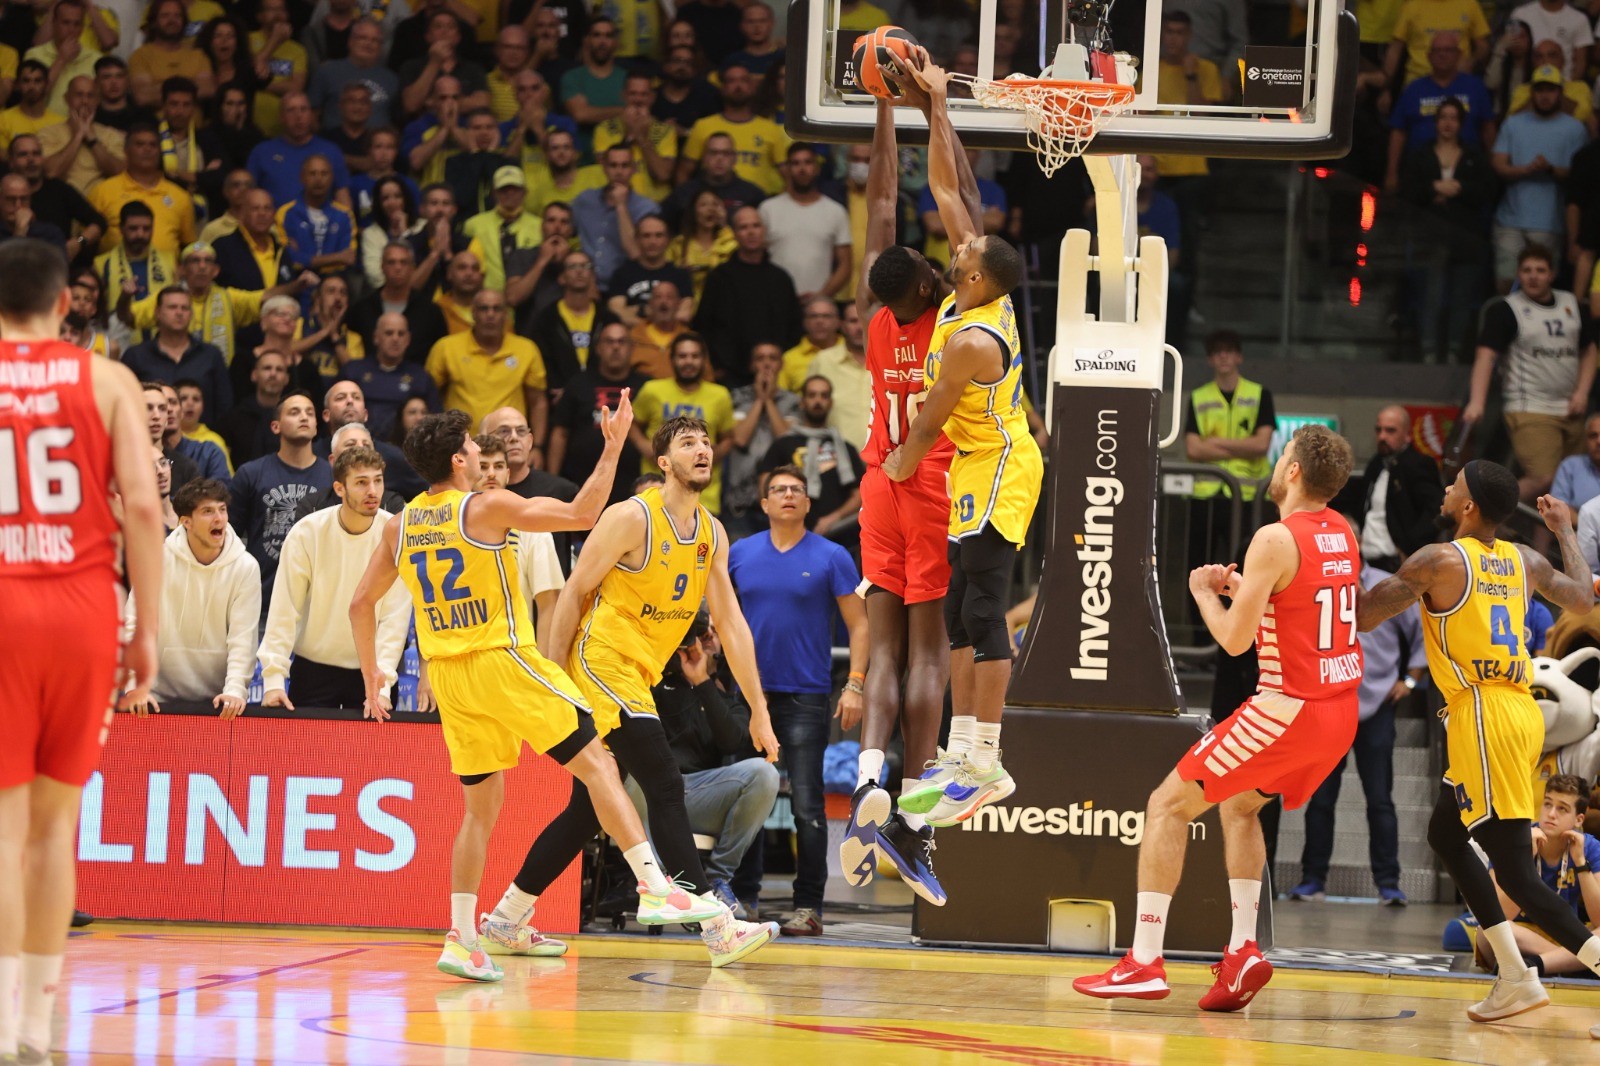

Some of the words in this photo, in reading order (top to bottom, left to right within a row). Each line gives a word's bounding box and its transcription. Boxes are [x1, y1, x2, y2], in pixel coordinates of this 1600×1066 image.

[1262, 73, 1302, 81] oneteam
[1545, 320, 1565, 337] 12
[895, 343, 918, 365] FALL
[1075, 359, 1136, 373] SPALDING
[0, 426, 82, 515] 16
[1069, 409, 1124, 681] Investing.com
[409, 547, 472, 604] 12
[1322, 560, 1353, 577] FMS
[671, 573, 689, 601] 9
[450, 598, 489, 631] AVIV
[640, 603, 695, 624] Playtika
[1313, 582, 1359, 652] 14
[1490, 604, 1519, 657] 4
[1455, 782, 1473, 813] 4
[1140, 913, 1162, 924] GSA
